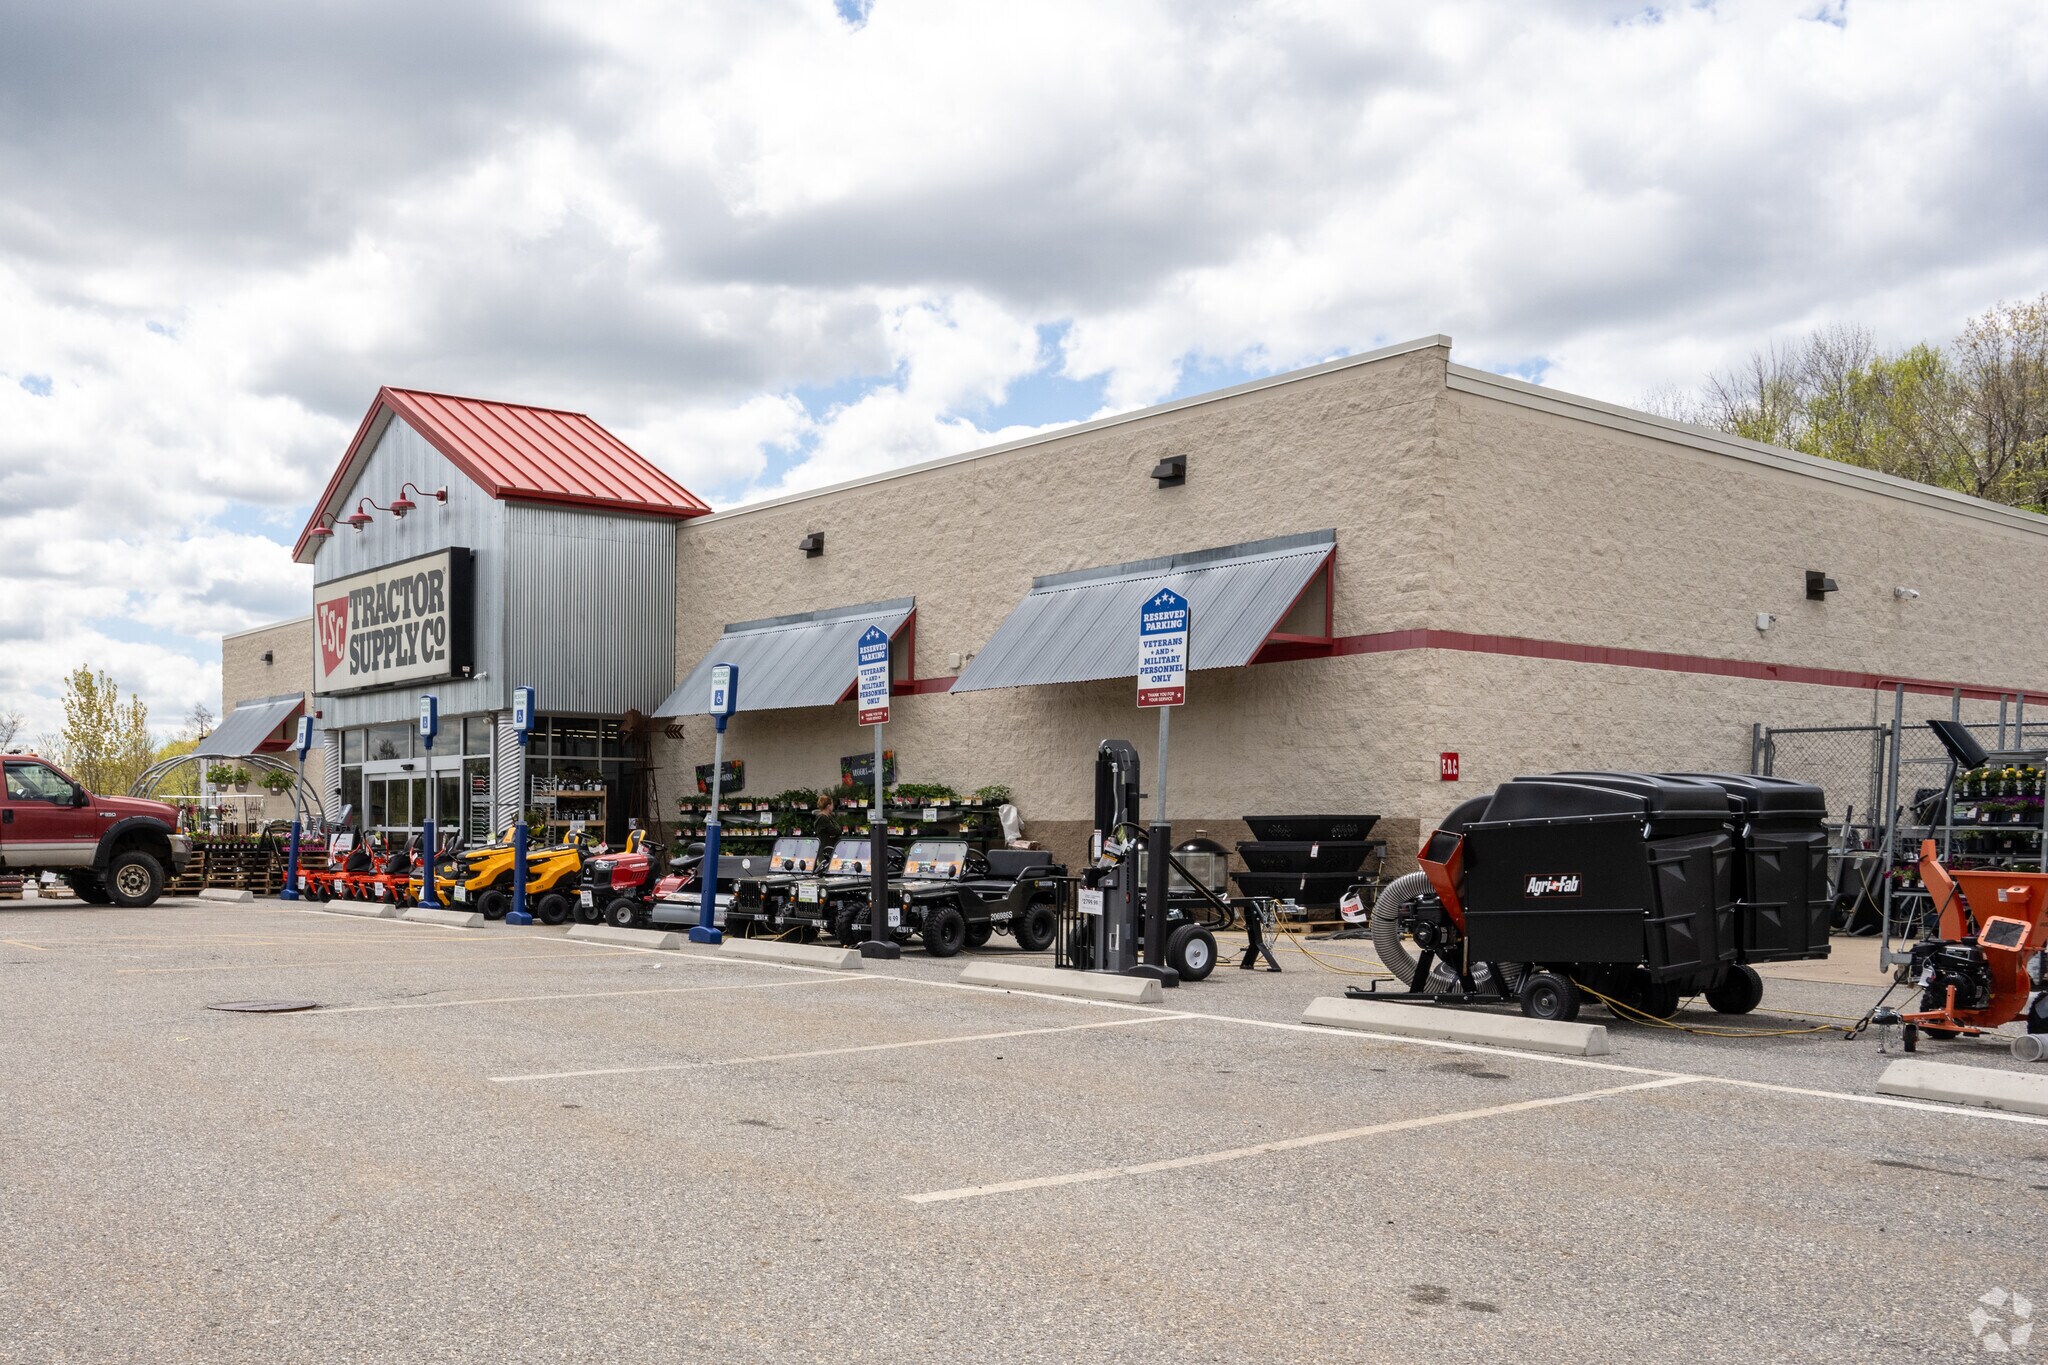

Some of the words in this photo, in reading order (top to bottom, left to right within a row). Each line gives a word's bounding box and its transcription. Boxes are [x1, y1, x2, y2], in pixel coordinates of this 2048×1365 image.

[349, 569, 445, 630] TRACTOR
[1143, 610, 1185, 622] RESERVED
[1145, 620, 1183, 631] PARKING
[320, 604, 344, 660] TSC
[349, 621, 420, 675] SUPPLY
[1143, 638, 1183, 648] VETERANS
[860, 643, 887, 655] RESERVED
[861, 651, 885, 662] PARKING
[1144, 655, 1181, 666] MILITARY
[860, 666, 886, 676] VETERANS
[1140, 664, 1184, 675] PERSONNEL
[1151, 674, 1172, 683] ONLY
[861, 681, 885, 691] MILITARY
[860, 688, 888, 699] PERSONNEL
[866, 697, 880, 705] ONLY
